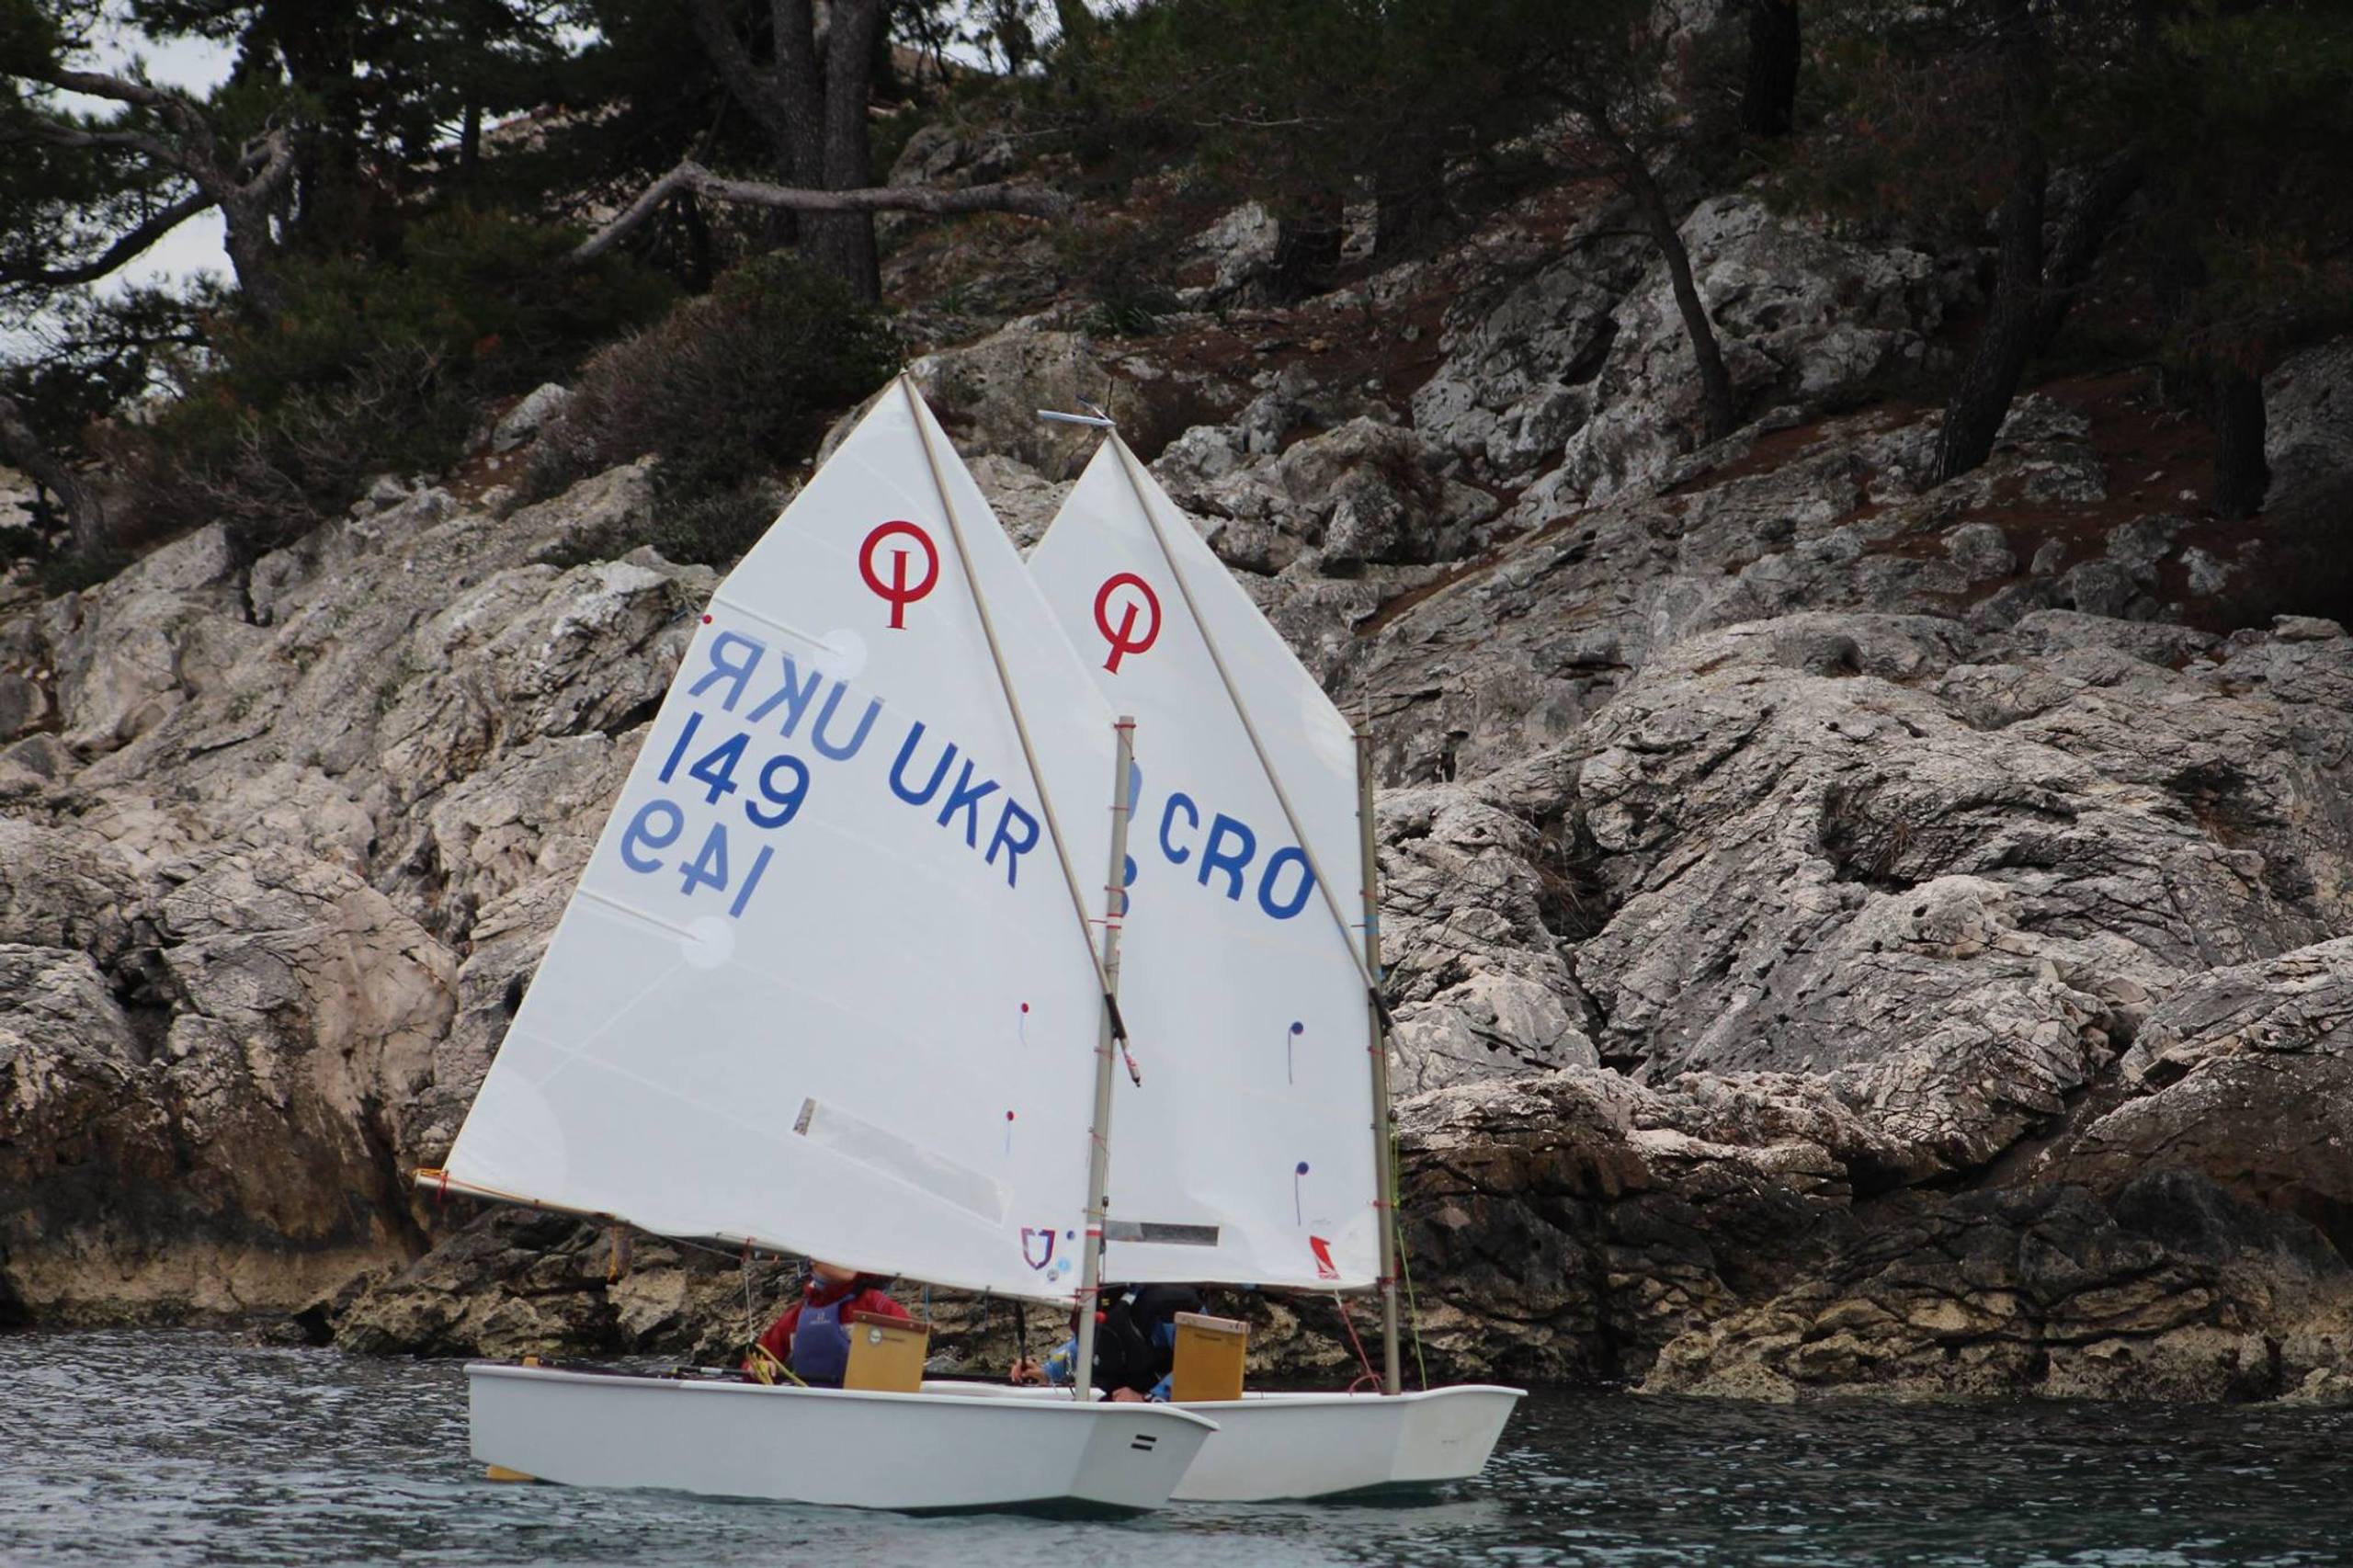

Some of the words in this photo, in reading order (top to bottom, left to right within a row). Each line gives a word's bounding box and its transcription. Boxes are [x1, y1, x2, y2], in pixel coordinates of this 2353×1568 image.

[657, 711, 811, 829] 149
[889, 721, 1040, 889] UKR
[1159, 792, 1317, 919] CRO
